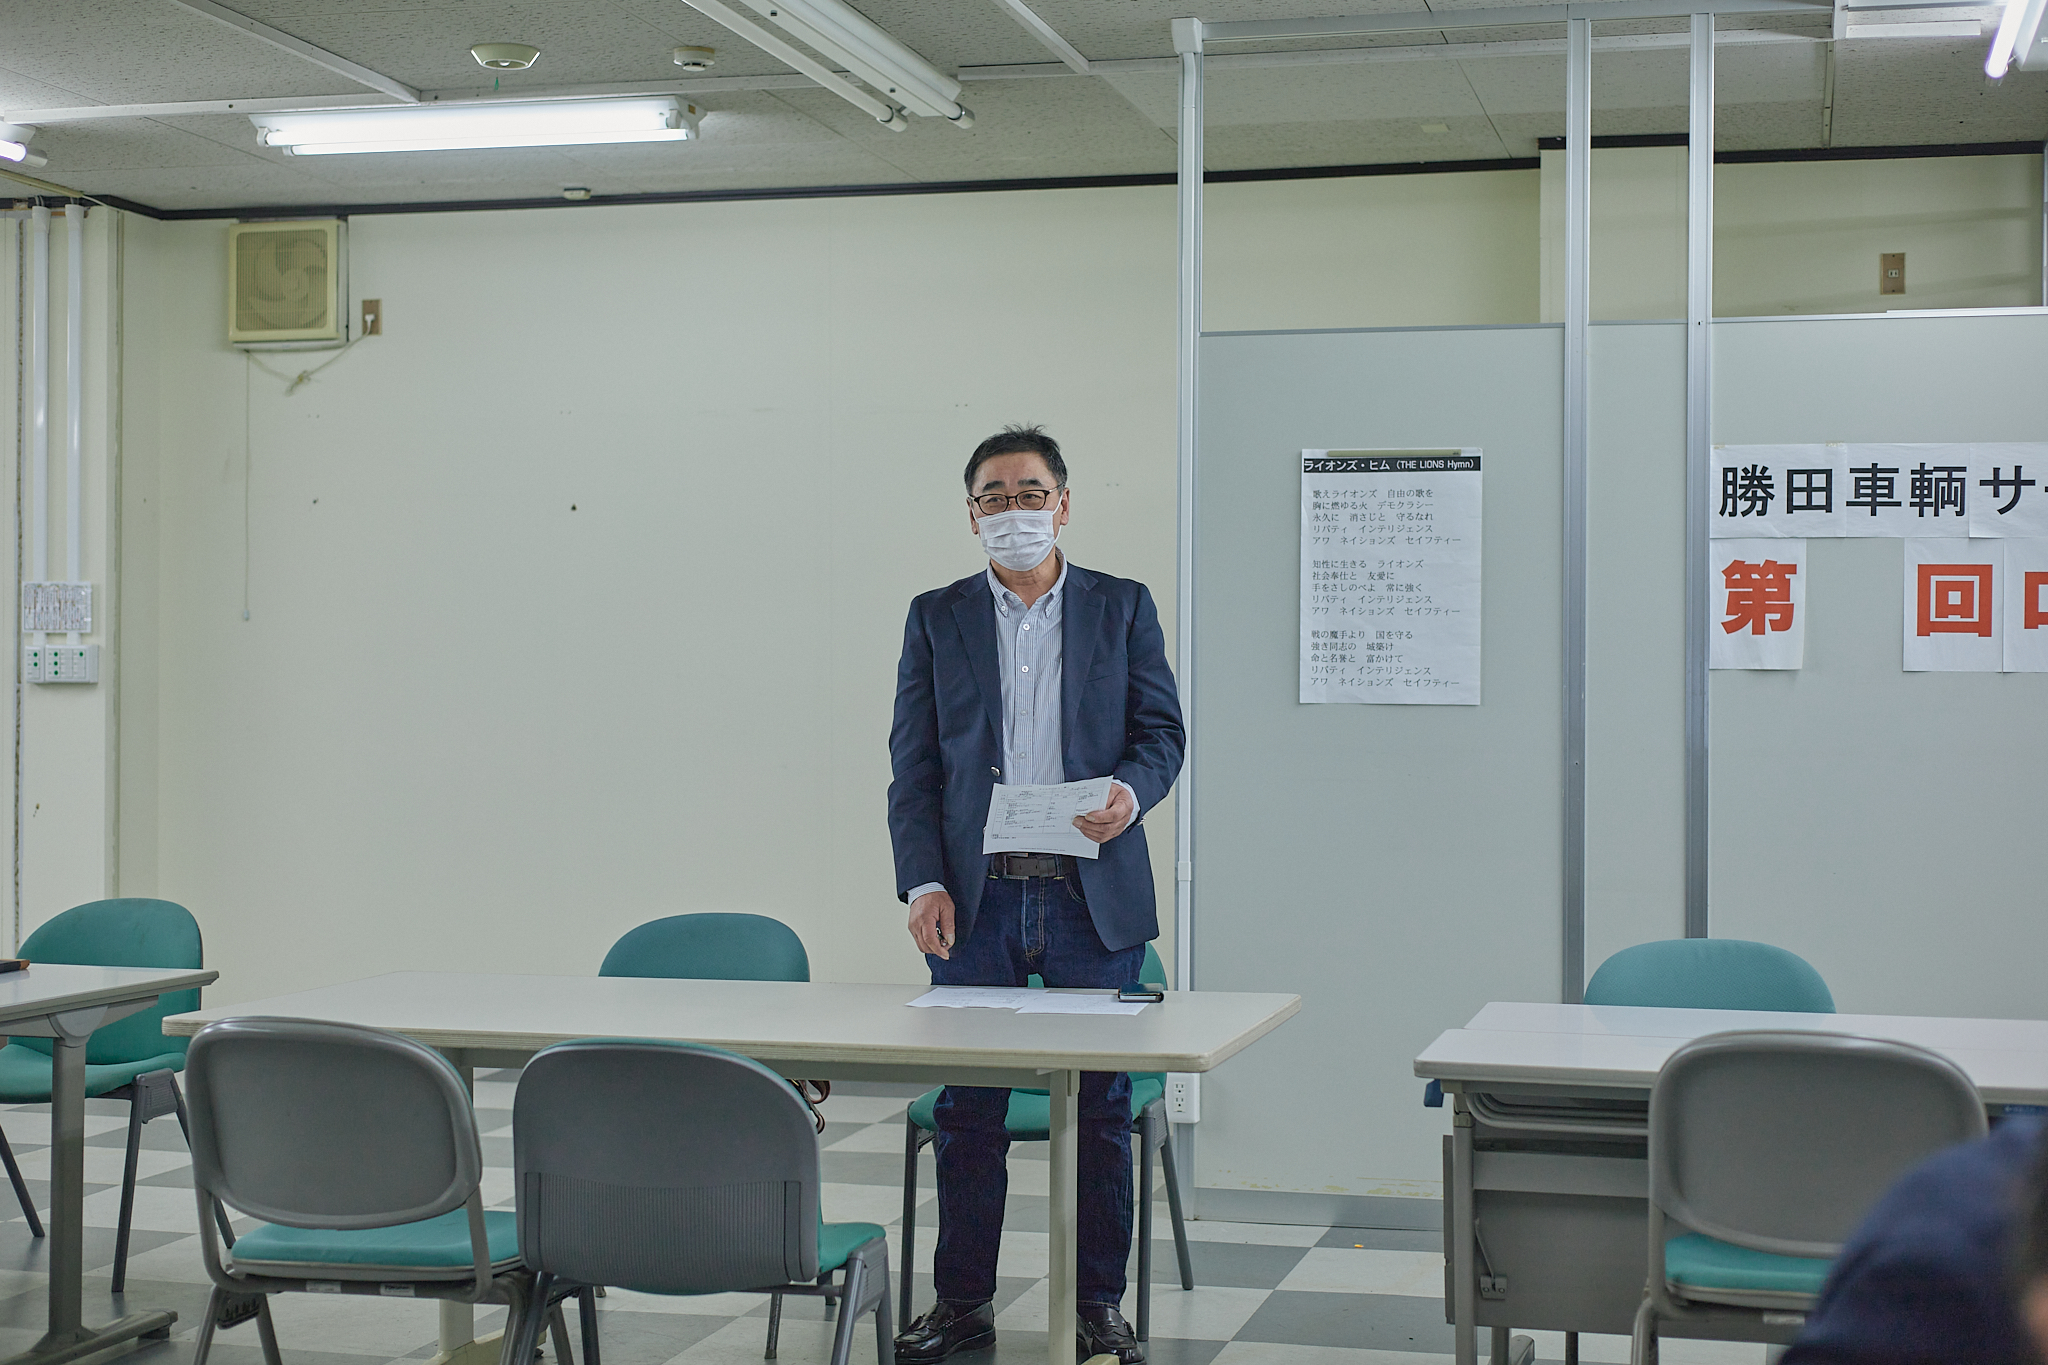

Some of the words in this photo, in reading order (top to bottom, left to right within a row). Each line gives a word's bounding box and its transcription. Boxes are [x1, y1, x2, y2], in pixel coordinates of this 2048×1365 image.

[1304, 459, 1390, 471] ライオンズ・ヒム
[1396, 460, 1417, 470] （THE
[1419, 459, 1445, 469] LIONS
[1447, 459, 1475, 471] Hymn）
[1312, 489, 1378, 499] 歌えライオンズ
[1387, 489, 1434, 498] 自由の歌を
[1718, 462, 2048, 518] 勝田車輌サ
[1312, 501, 1368, 510] 胸に燃ゆる火
[1377, 501, 1434, 510] デモクラシー
[1312, 513, 1340, 522] 永久に
[1349, 512, 1386, 522] 消さじと
[1396, 512, 1434, 522] 守るなれ
[1358, 524, 1433, 533] インテリジェンス
[1312, 536, 1330, 545] アワ
[1340, 536, 1396, 545] ネイションズ
[1405, 536, 1461, 545] セイフティー
[1312, 559, 1367, 569] 知性に生きる
[1377, 559, 1424, 569] ライオンズ
[1312, 571, 1357, 581] 社会奉仕と
[1367, 571, 1395, 581] 友愛に
[1312, 583, 1376, 592] 手をさしのべよ
[1385, 583, 1422, 592] 常に強く
[1358, 595, 1432, 604] インテリジェンス
[1720, 559, 1798, 636] 第
[1311, 607, 1329, 615] アワ
[1339, 606, 1395, 616] ネイションズ
[1404, 606, 1460, 616] セイフティー
[1310, 630, 1366, 640] 戦の魔手より
[1375, 630, 1413, 640] 国を守る
[1310, 642, 1357, 651] 強き同志の
[1366, 642, 1394, 651] 城築け
[1310, 654, 1356, 663] 命と名誉と
[1366, 654, 1404, 663] 富かけて
[1356, 666, 1432, 675] インテリジェンス
[1310, 677, 1328, 686] アワ
[1338, 677, 1394, 687] ネイションズ
[1403, 678, 1460, 688] セイフティー
